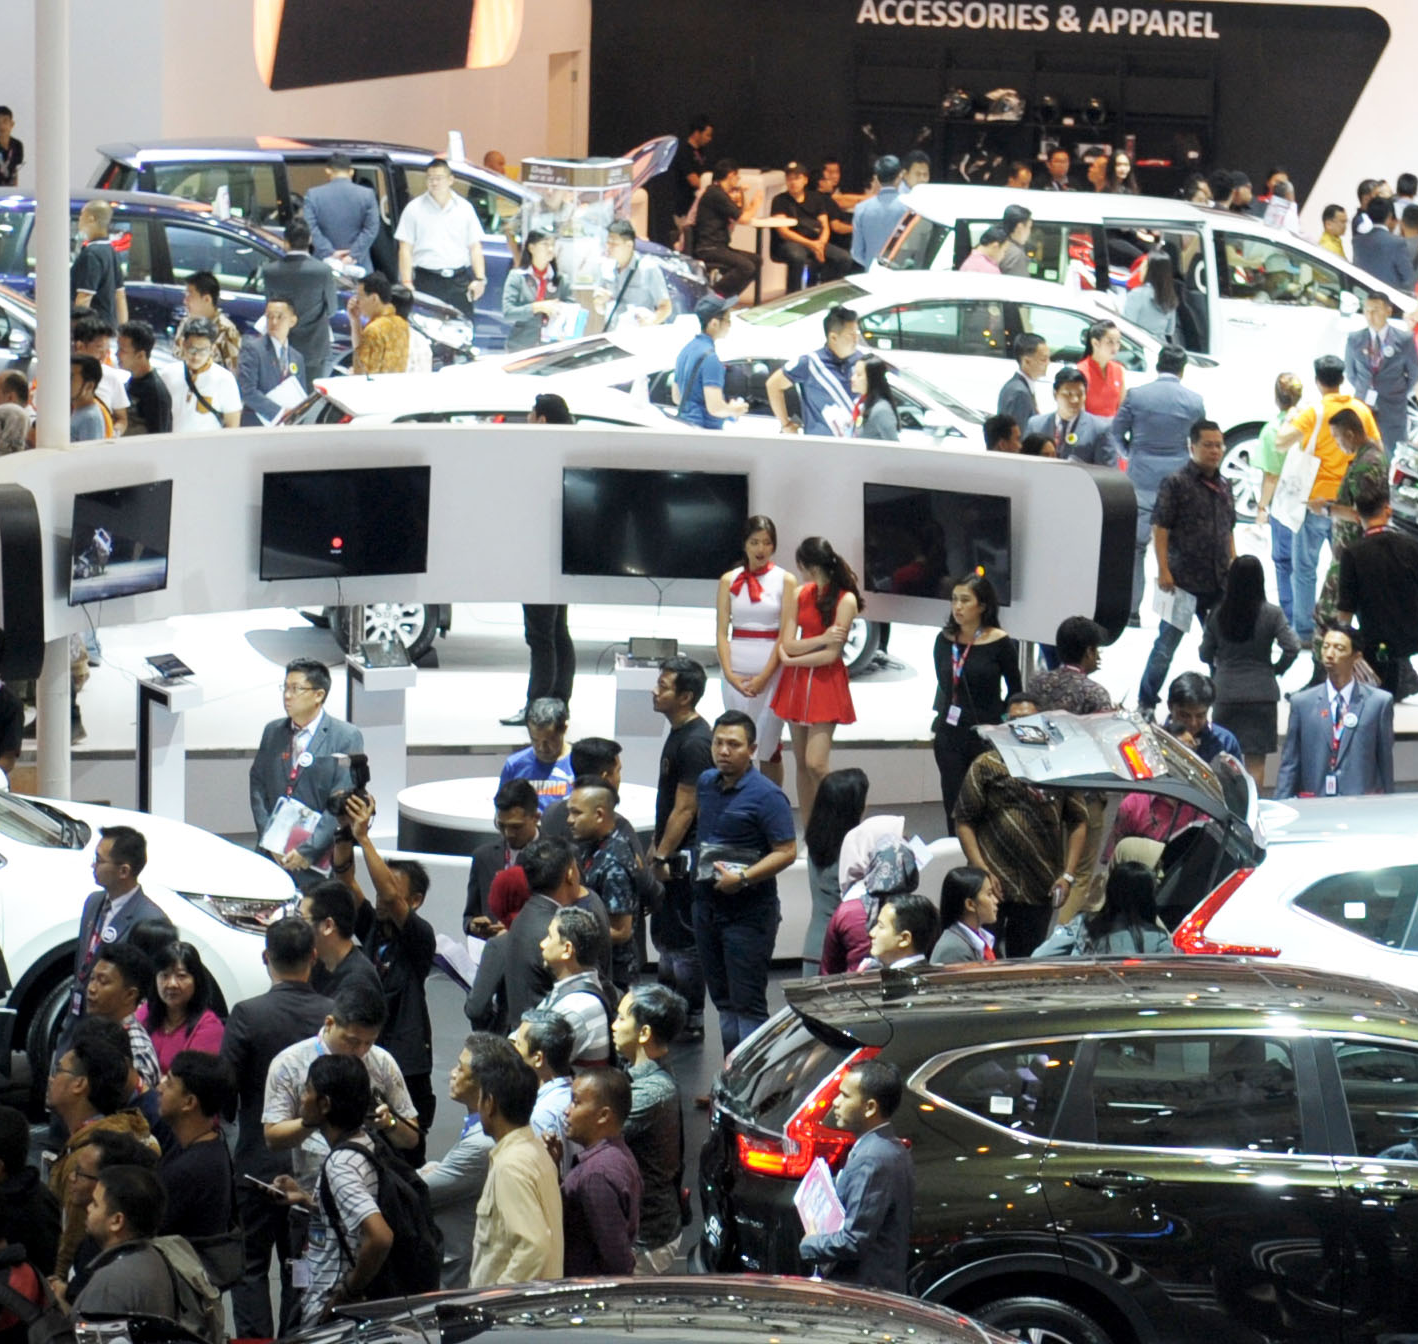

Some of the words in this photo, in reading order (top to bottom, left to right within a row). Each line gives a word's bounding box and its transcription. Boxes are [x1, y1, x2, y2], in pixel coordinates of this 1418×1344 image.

[856, 0, 1051, 32] ACCESSORIES
[1056, 6, 1082, 32] &
[1088, 8, 1221, 39] APPAREL
